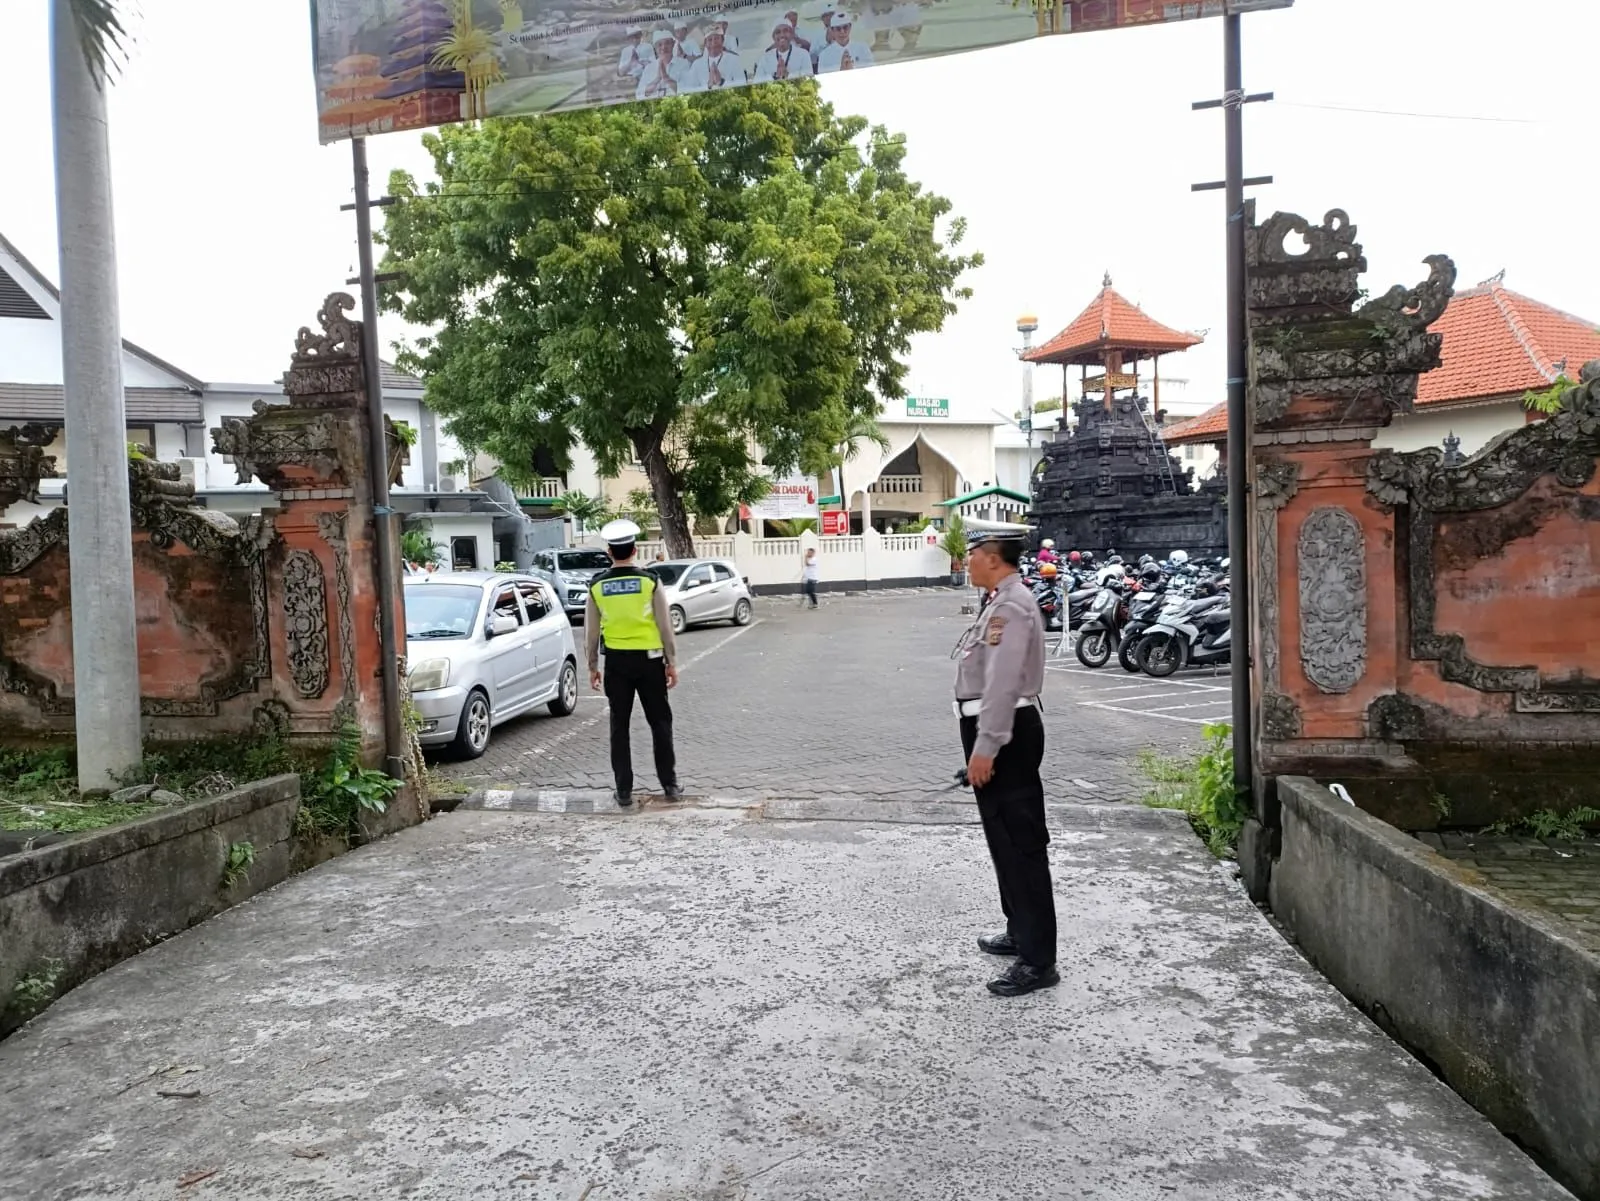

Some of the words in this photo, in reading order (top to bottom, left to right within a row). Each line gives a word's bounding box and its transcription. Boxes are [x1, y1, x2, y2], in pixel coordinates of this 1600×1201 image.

[668, 7, 700, 19] datang
[702, 2, 721, 13] dari
[915, 398, 941, 408] MASJID
[908, 408, 928, 416] NURUL
[932, 408, 949, 417] HUDA
[782, 485, 809, 494] DARAH
[603, 580, 640, 594] POLISI
